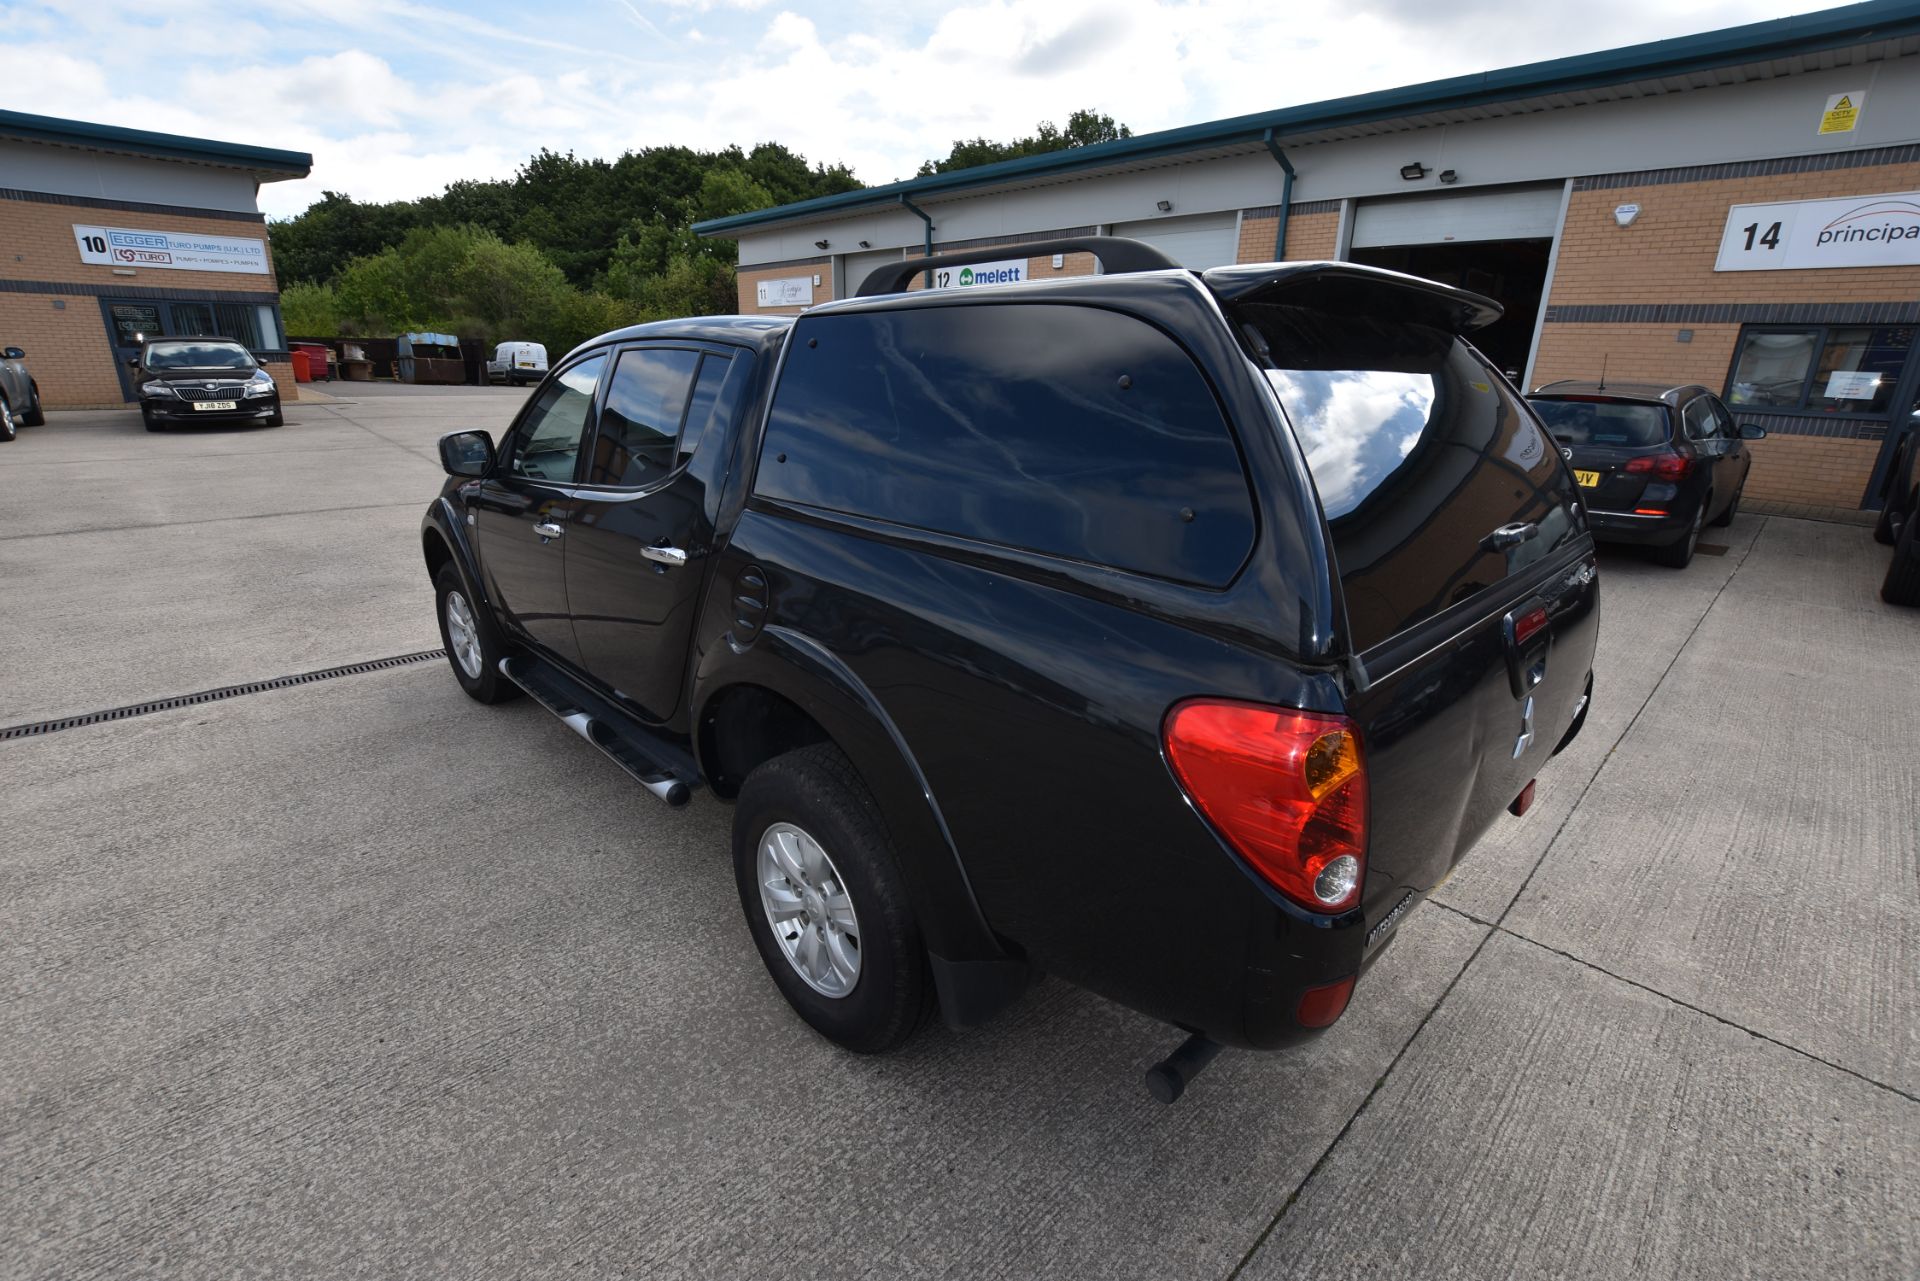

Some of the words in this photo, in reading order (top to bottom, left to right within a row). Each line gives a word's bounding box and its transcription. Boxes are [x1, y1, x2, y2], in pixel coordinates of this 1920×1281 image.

[113, 235, 165, 247] EGGER
[1743, 221, 1783, 251] 14
[82, 235, 106, 254] 10
[168, 241, 191, 249] TURO
[193, 243, 222, 251] PUMPS
[138, 252, 165, 262] TURO
[937, 271, 951, 288] 12
[975, 267, 1020, 284] melett
[759, 287, 767, 300] 11
